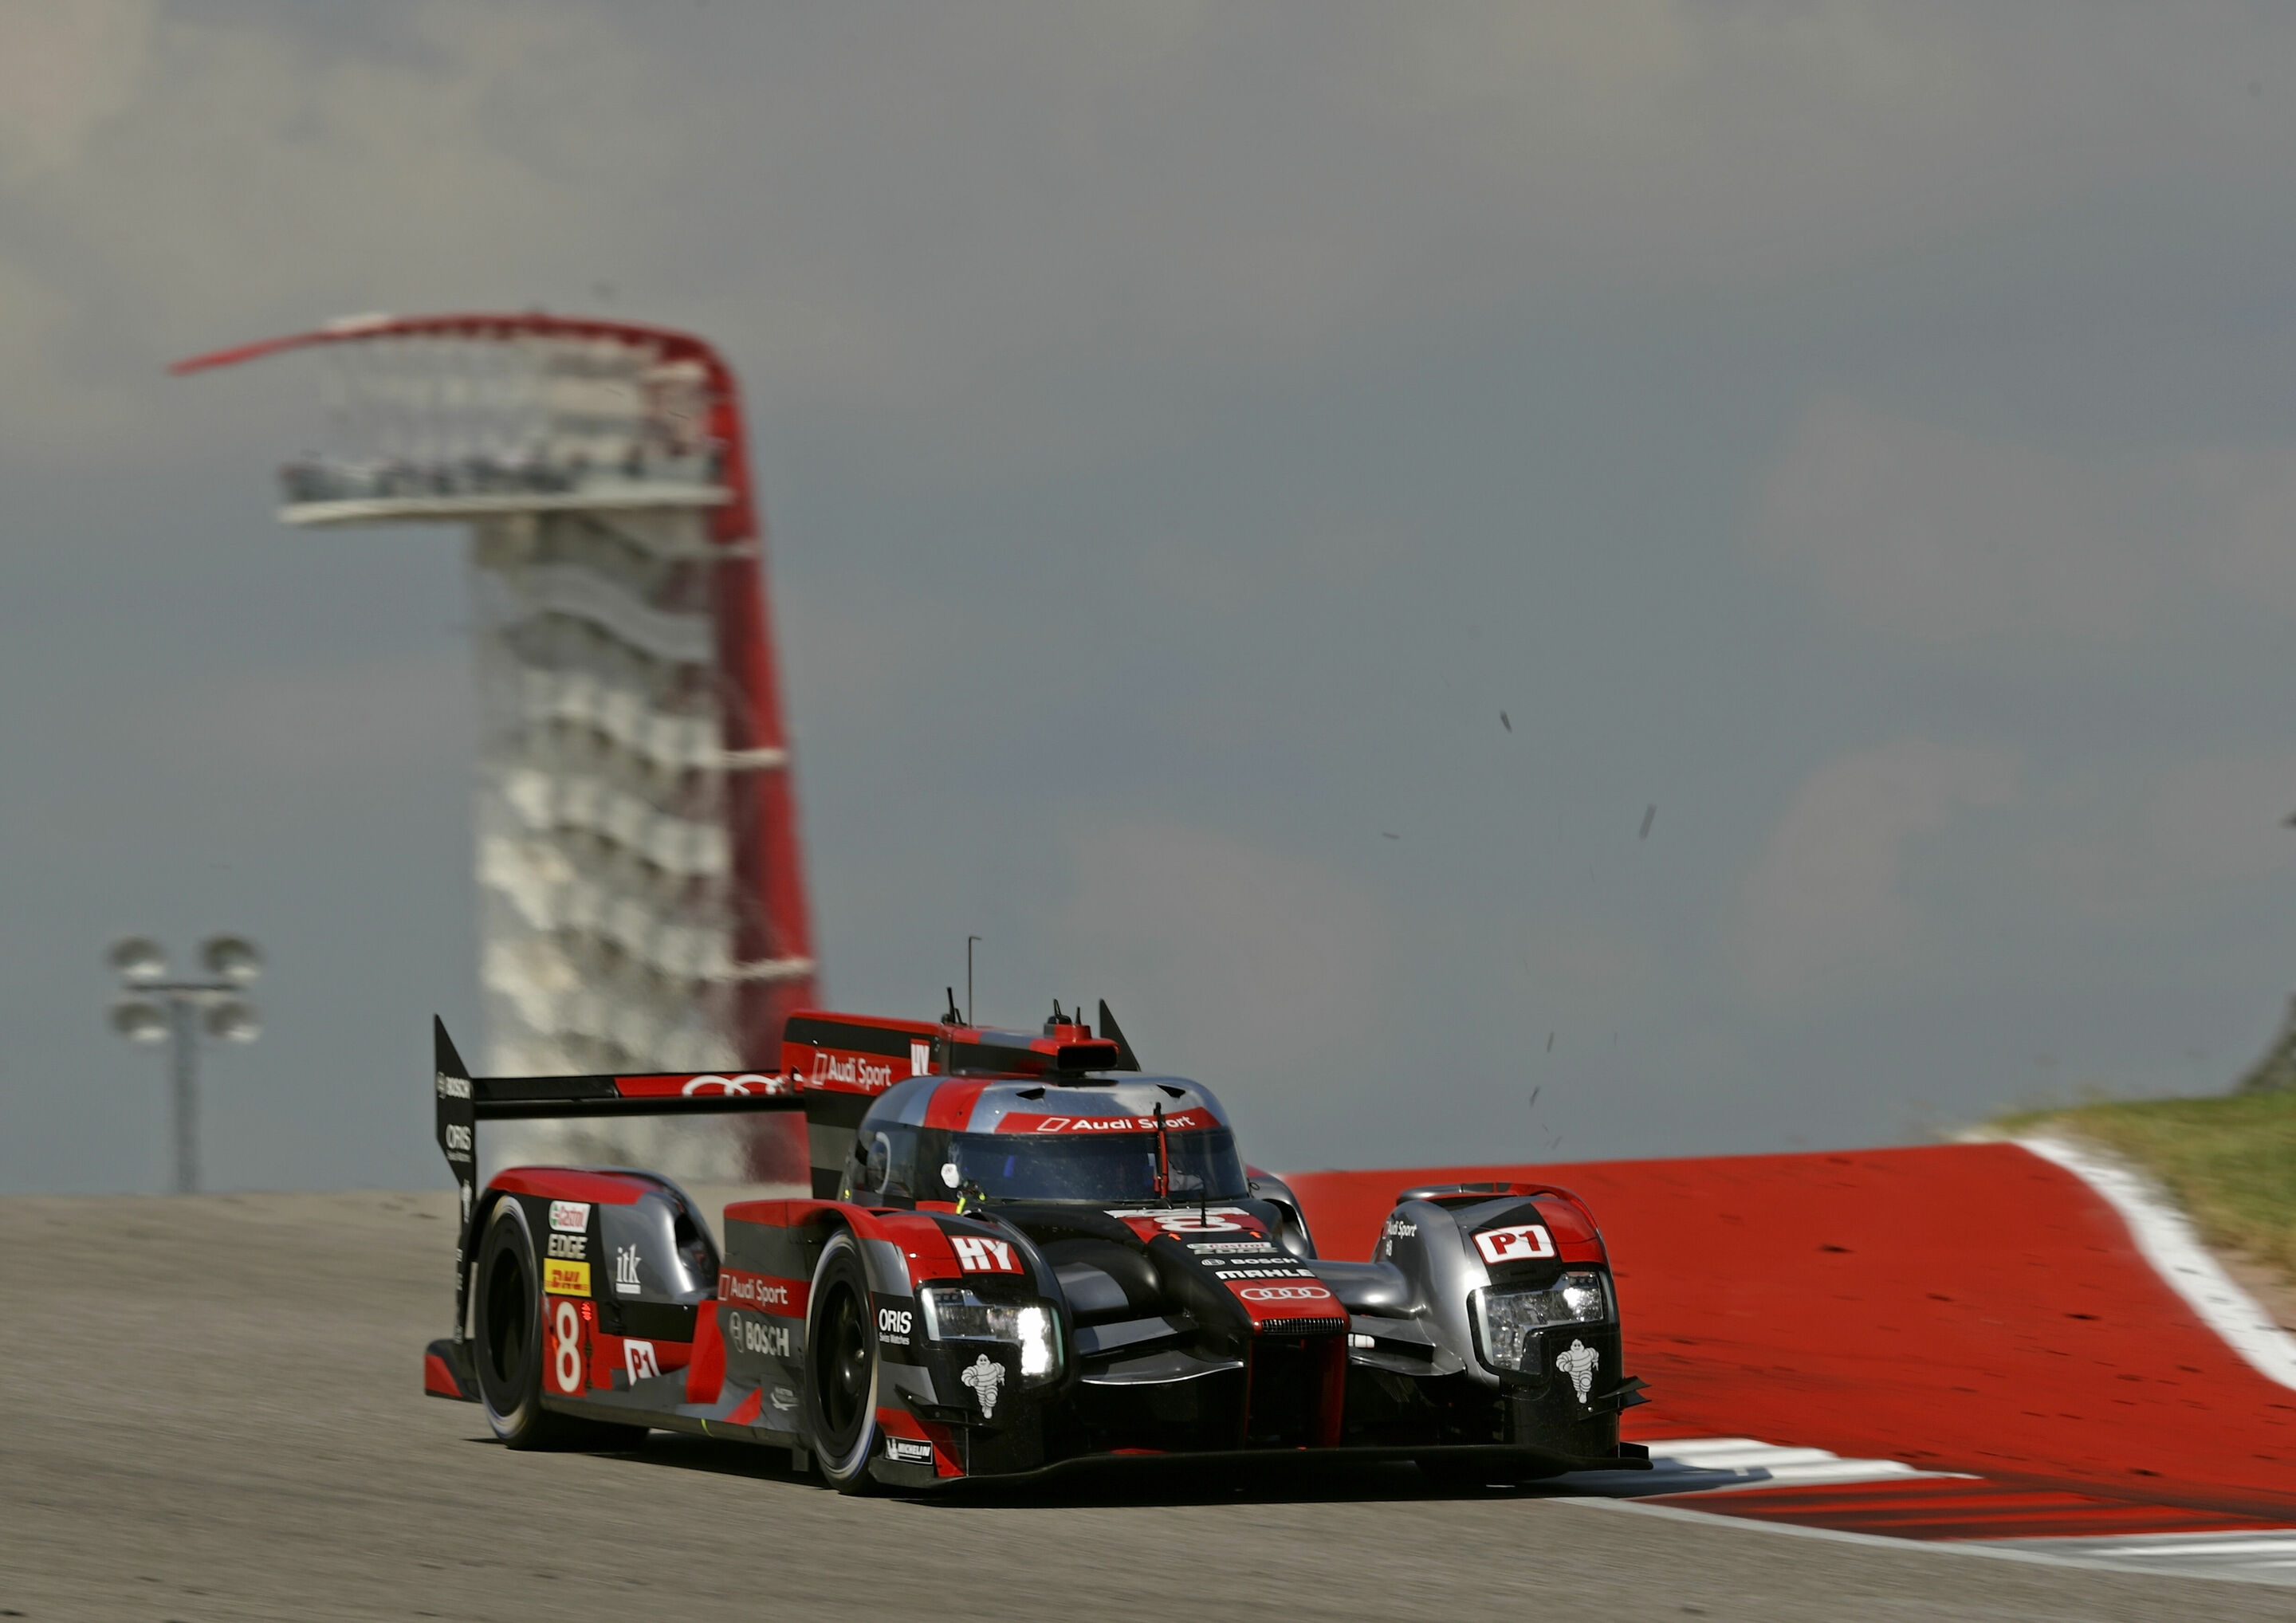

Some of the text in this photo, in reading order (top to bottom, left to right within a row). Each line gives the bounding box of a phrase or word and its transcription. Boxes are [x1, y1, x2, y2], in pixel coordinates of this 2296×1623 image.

[828, 1047, 892, 1091] Audi Sport
[1071, 1119, 1133, 1130] Audi
[1154, 1216, 1241, 1232] 8
[1398, 1220, 1417, 1240] Sport
[548, 1234, 588, 1259] EDGE
[952, 1238, 1012, 1270] HY
[1489, 1231, 1541, 1255] P1
[616, 1244, 641, 1283] itk
[1215, 1269, 1315, 1279] MAHLE
[730, 1276, 788, 1307] Audi Sport
[879, 1308, 912, 1334] ORIS
[556, 1301, 581, 1393] 8
[745, 1320, 790, 1357] BOSCH
[631, 1348, 655, 1377] P1
[898, 1442, 931, 1457] MICHELIN
